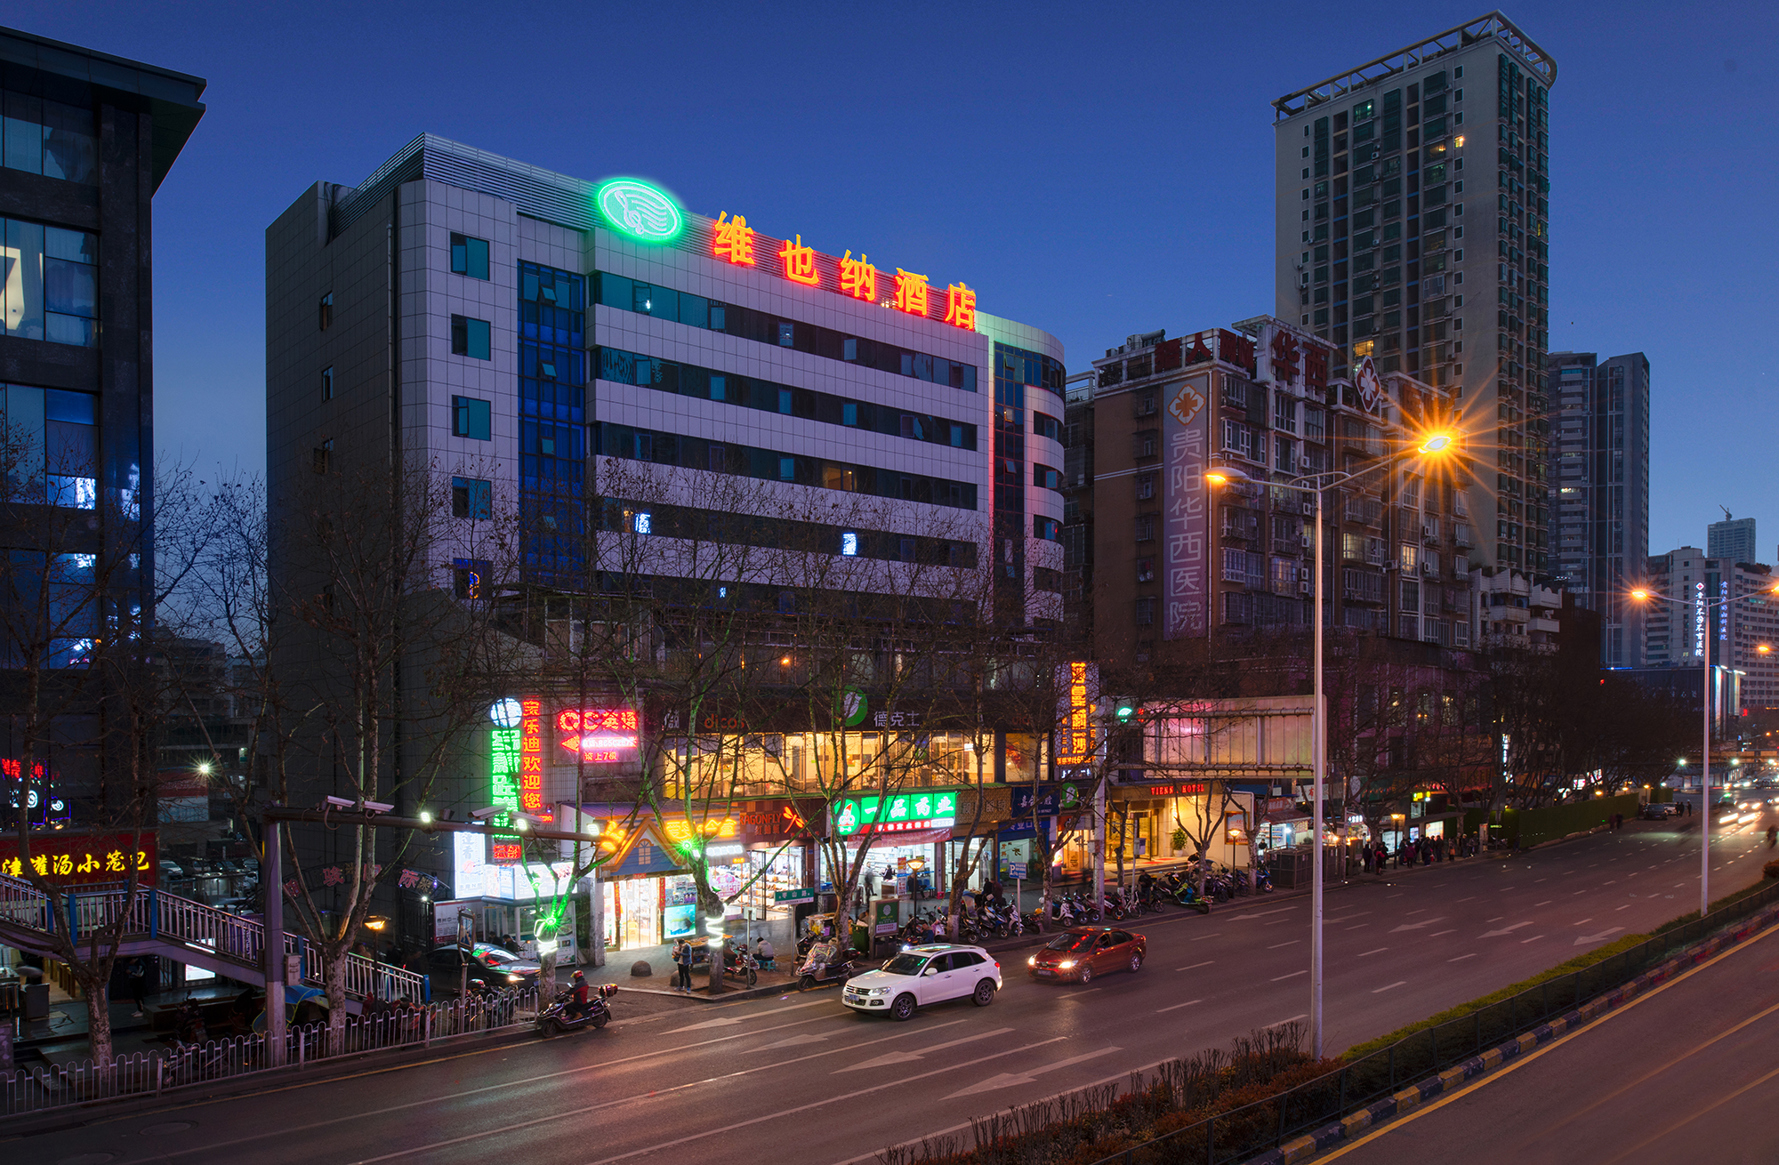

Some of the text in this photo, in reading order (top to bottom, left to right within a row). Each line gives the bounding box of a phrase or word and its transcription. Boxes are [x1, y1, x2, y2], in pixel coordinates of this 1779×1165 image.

[714, 210, 977, 330] 维也纳酒店
[1272, 329, 1329, 391] 华西
[1169, 428, 1205, 632] 贵阳华西医院
[873, 710, 920, 728] 德克士
[1151, 786, 1179, 796] VIENN
